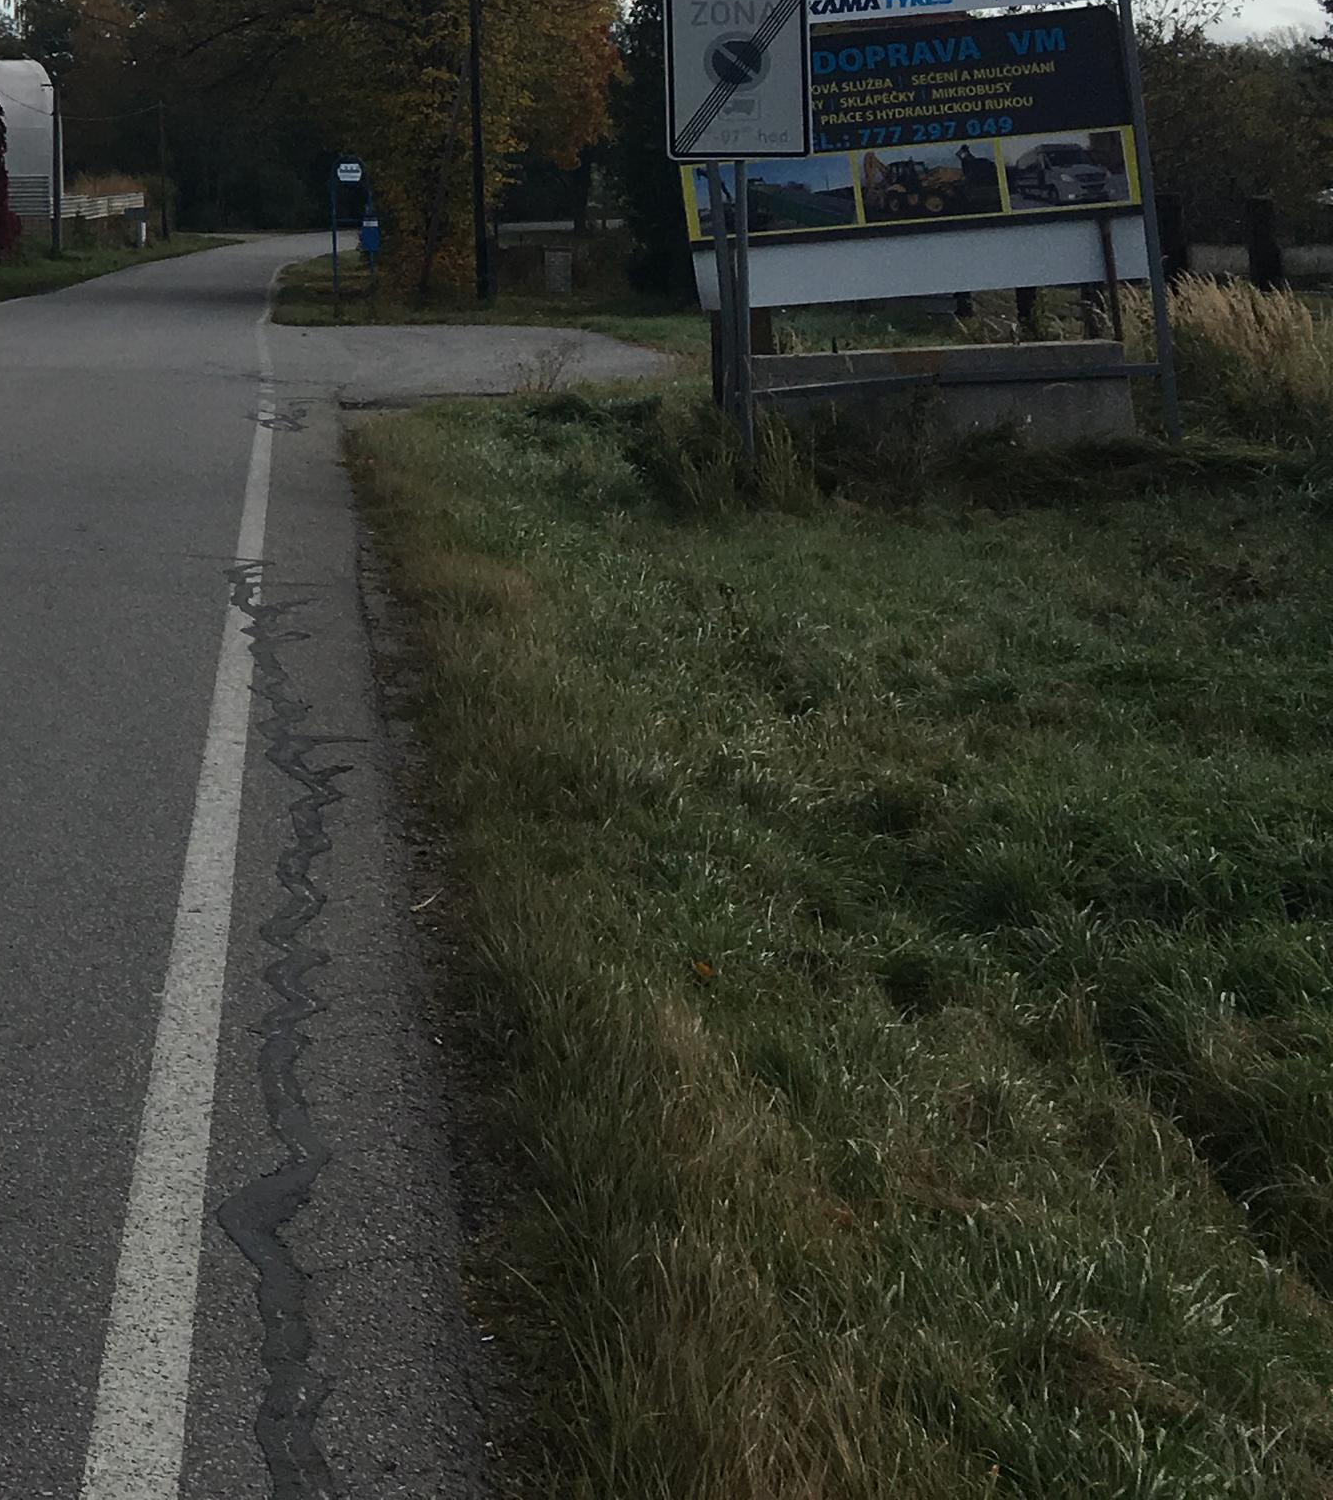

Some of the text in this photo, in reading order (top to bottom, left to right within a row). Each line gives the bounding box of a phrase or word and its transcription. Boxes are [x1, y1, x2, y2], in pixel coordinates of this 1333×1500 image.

[812, 27, 1066, 75] DOPRAVA VM
[842, 77, 893, 93] SLUŽBA
[911, 69, 958, 86] SEČENÍ
[961, 70, 971, 81] A
[974, 59, 1056, 80] MULČOVÁNÍ
[932, 82, 1013, 100] MIKROBUSY
[820, 96, 1034, 125] PRÁCE S HYDRAULICKOU RUKOU
[858, 126, 902, 147] 777
[912, 120, 957, 141] 297
[965, 115, 1014, 137] 049
